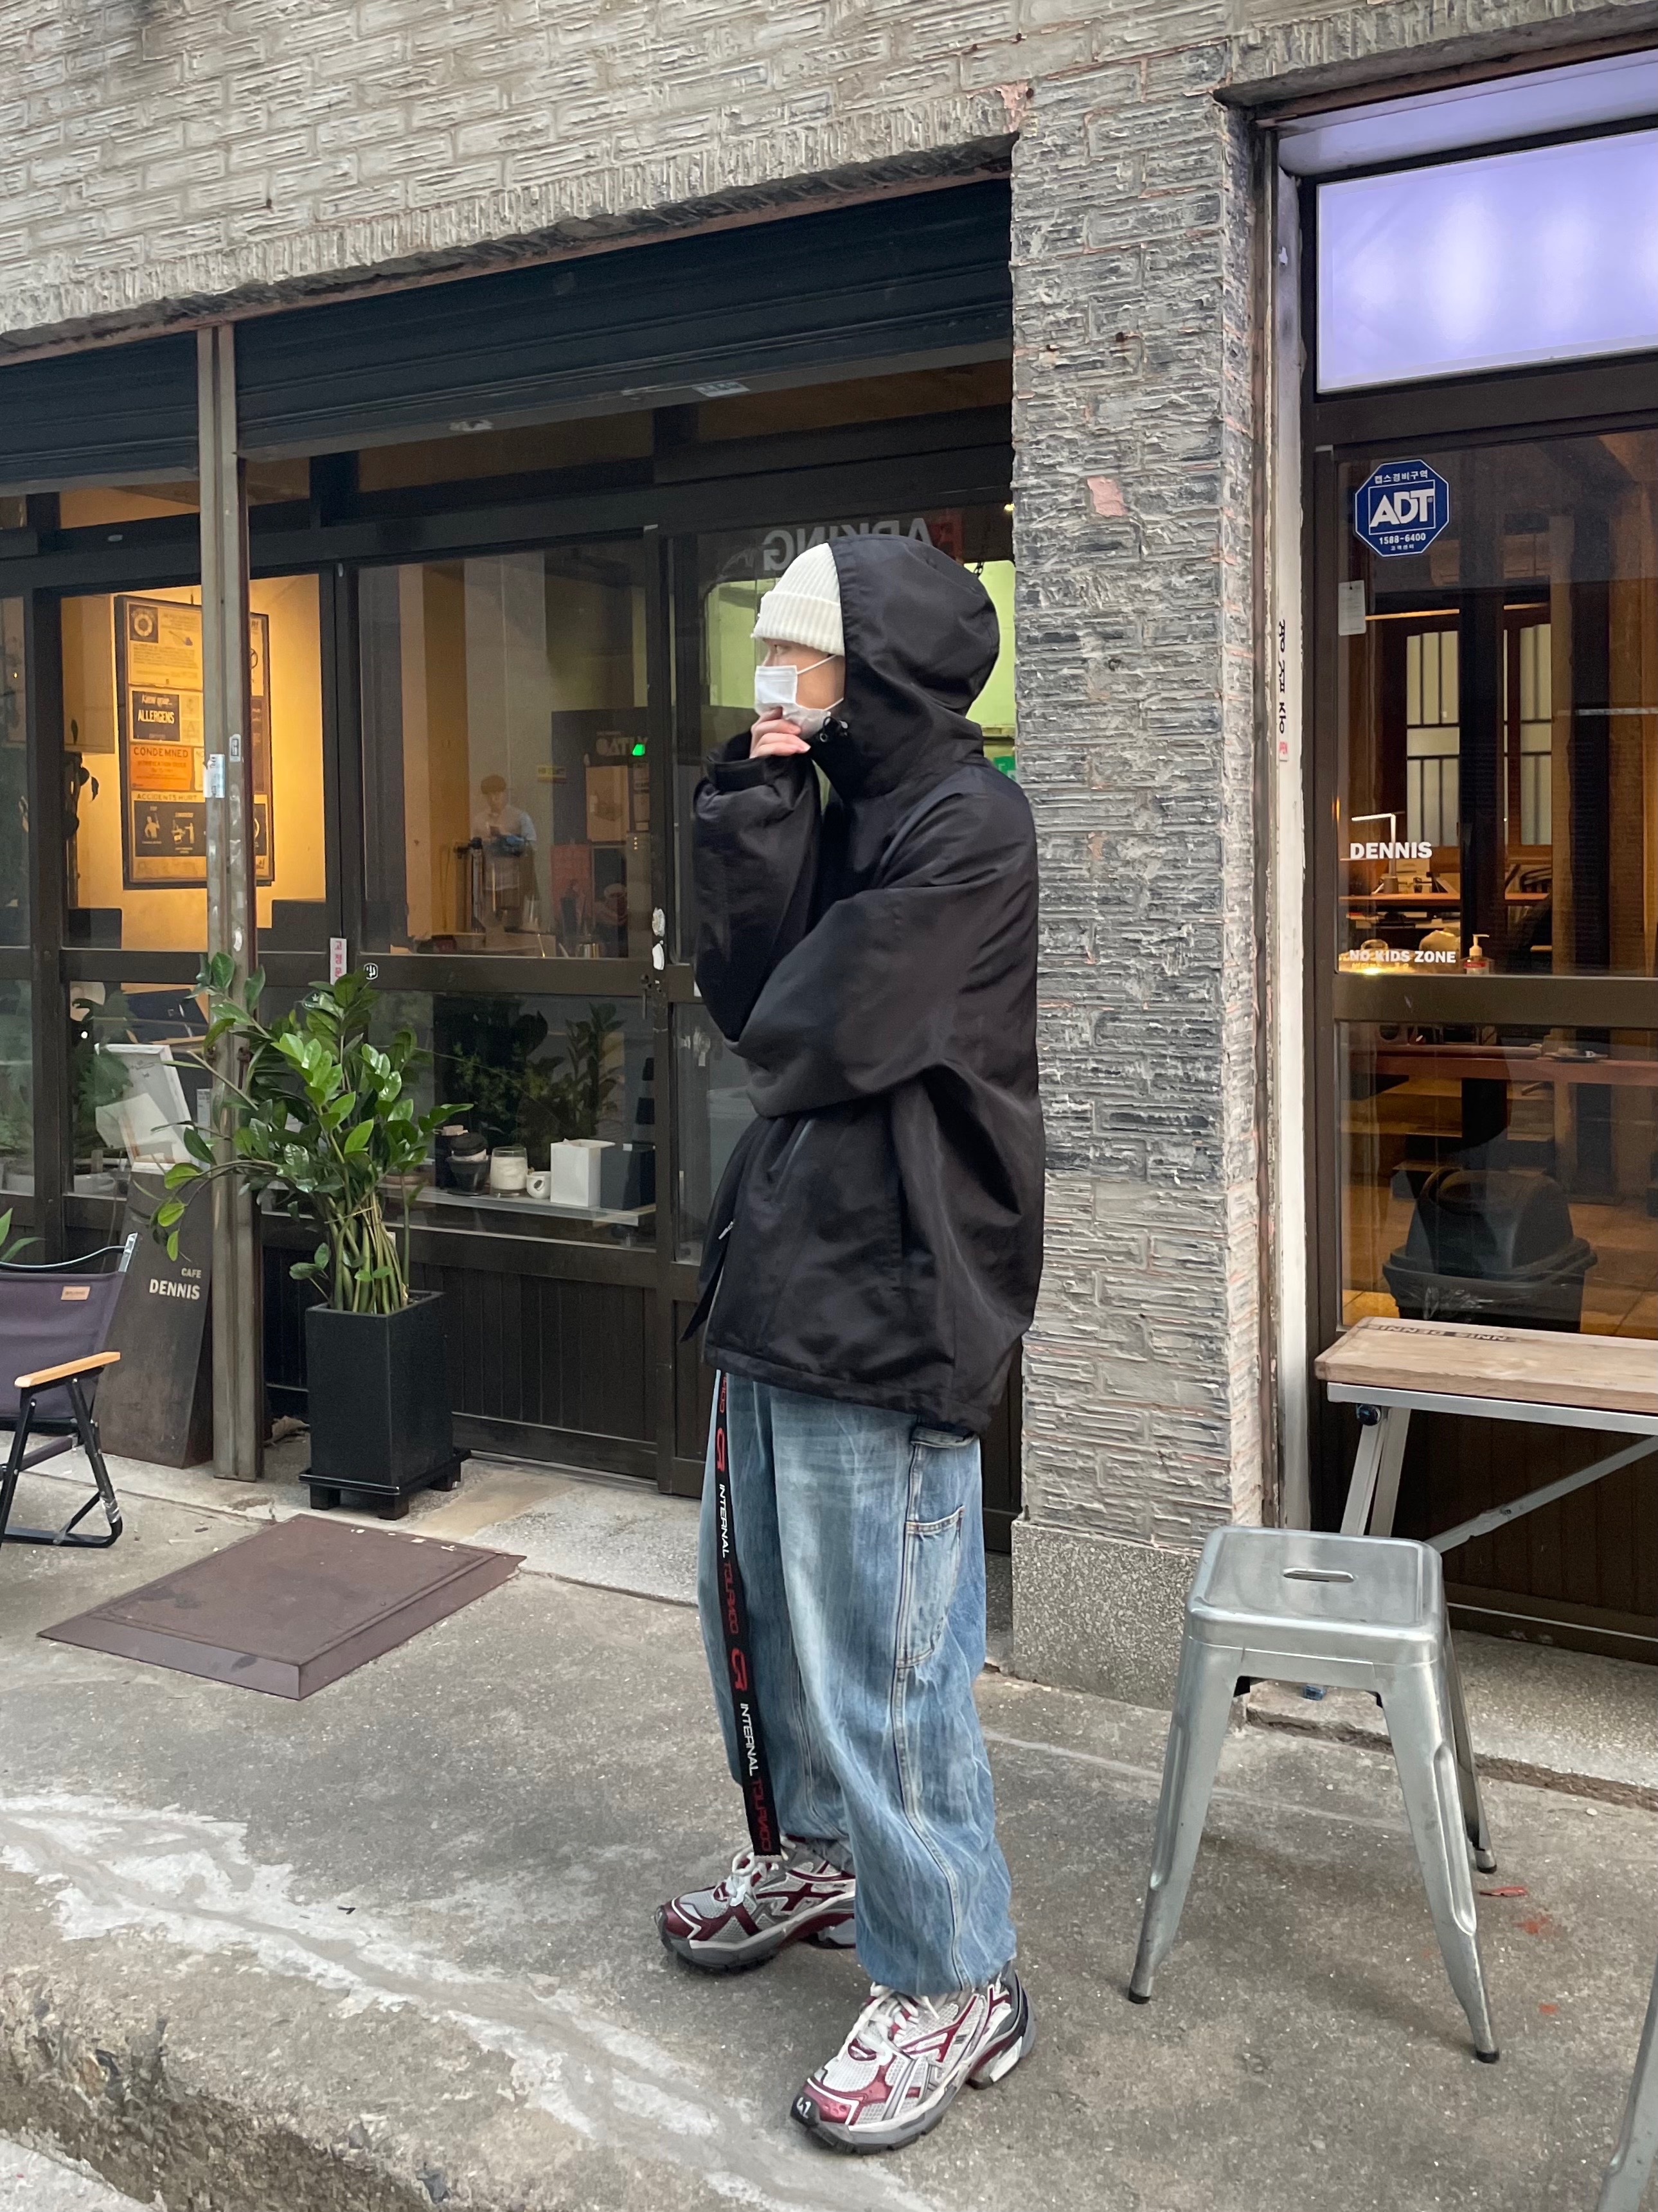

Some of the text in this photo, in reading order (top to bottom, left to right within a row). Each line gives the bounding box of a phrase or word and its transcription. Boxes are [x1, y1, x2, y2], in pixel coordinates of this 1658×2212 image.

[1369, 488, 1435, 527] ADT
[1379, 533, 1426, 545] 1588-6400
[138, 709, 175, 724] ALLERGENS
[134, 747, 189, 758] CONDEMNED
[1350, 841, 1432, 859] DENNIS
[1350, 950, 1456, 963] NO KIDS ZONE
[181, 1268, 202, 1279] CAFE
[149, 1278, 201, 1300] DENNIS
[719, 1483, 729, 1558] INTERNAL
[740, 1702, 758, 1777] INTERNAL
